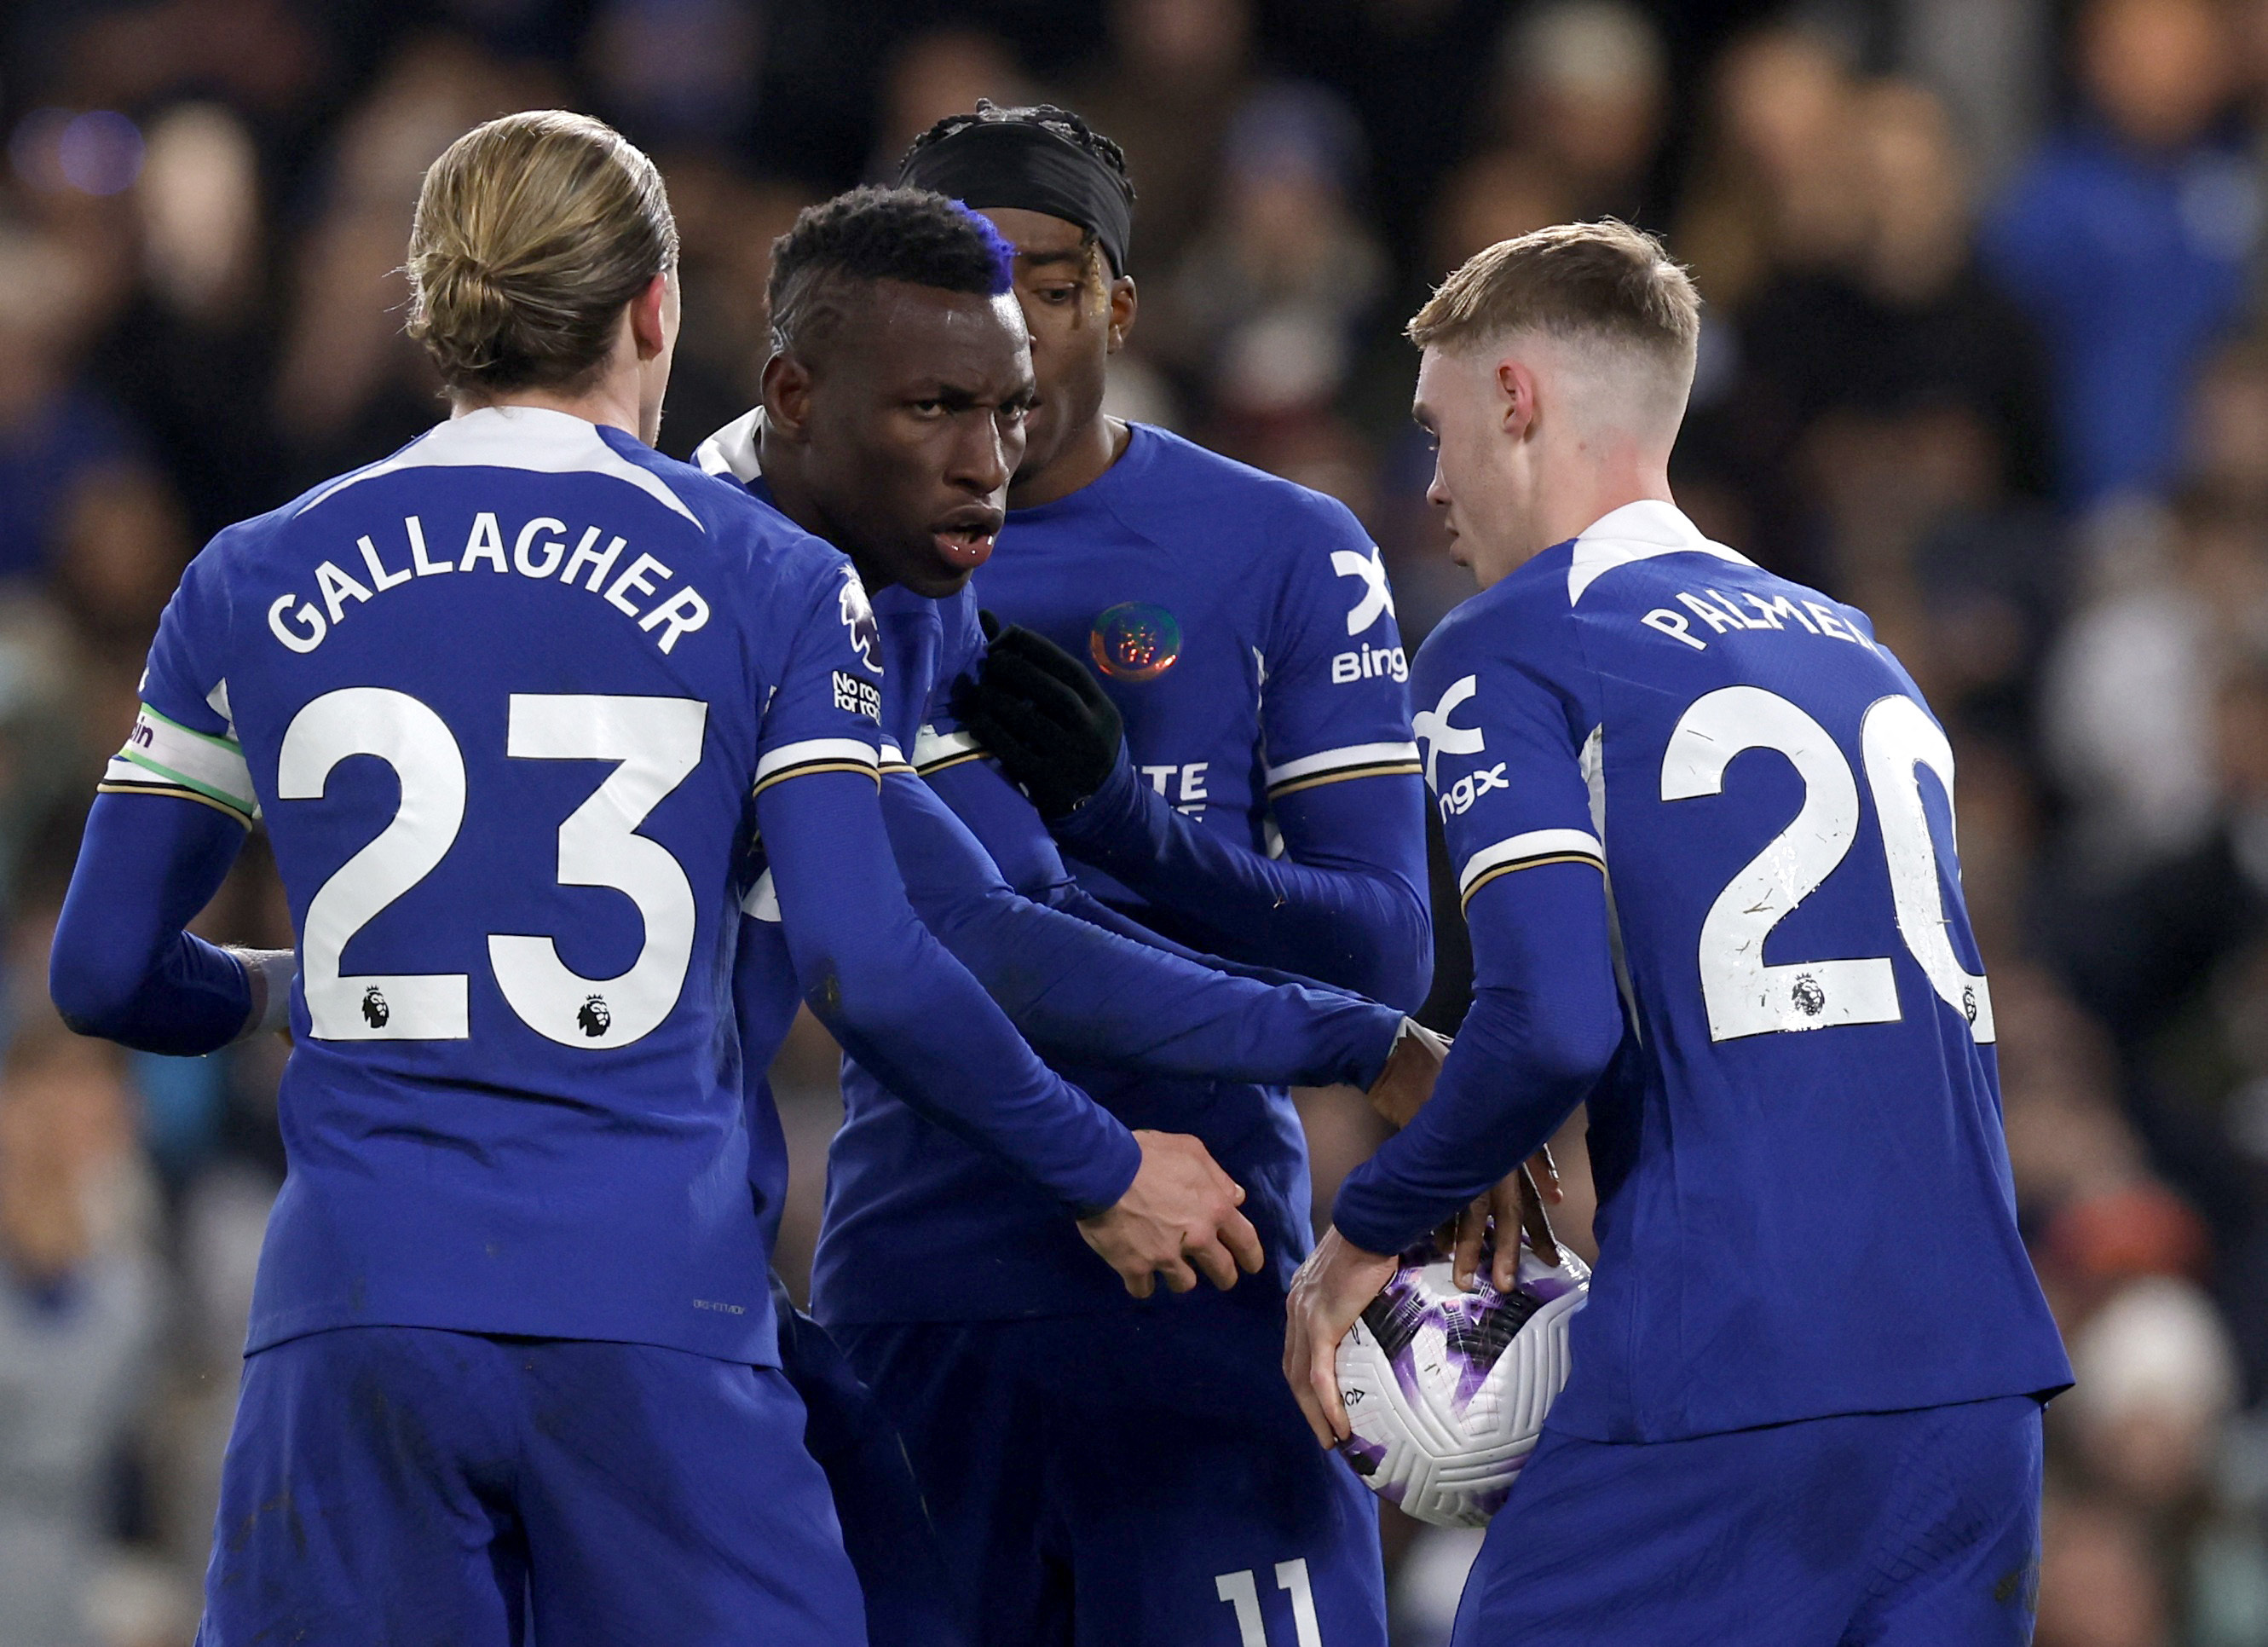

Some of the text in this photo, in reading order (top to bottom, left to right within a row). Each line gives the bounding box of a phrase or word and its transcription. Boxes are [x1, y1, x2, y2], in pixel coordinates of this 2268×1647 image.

[268, 511, 711, 655] GALLAGHER
[832, 670, 857, 696] No
[1332, 642, 1409, 684] Bing
[1439, 762, 1509, 824] ngx
[277, 686, 708, 1049] 23
[1660, 685, 1996, 1043] 20
[1215, 1557, 1322, 1647] 11
